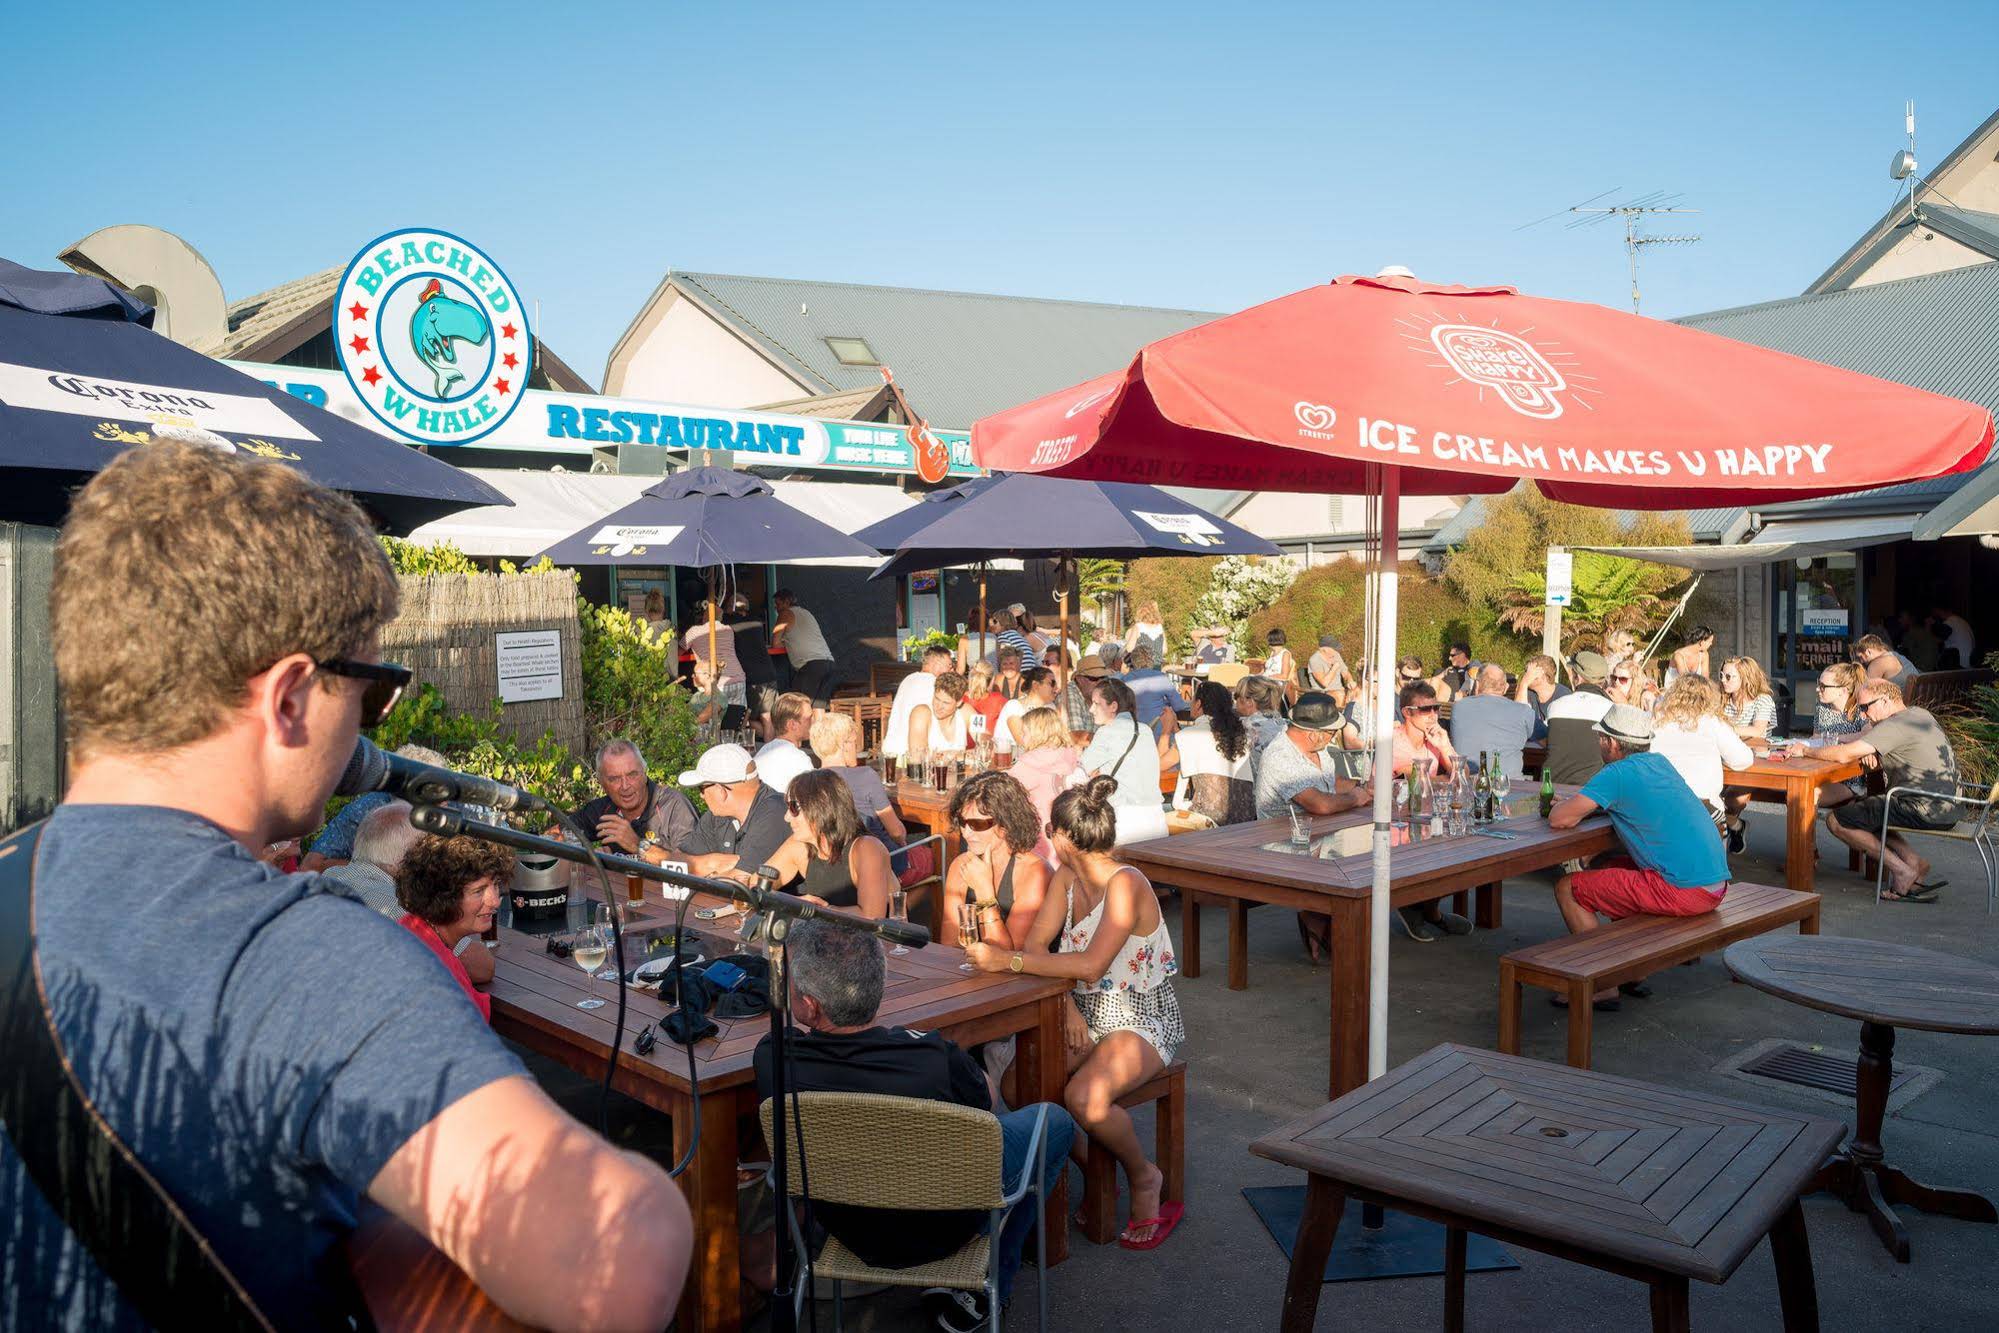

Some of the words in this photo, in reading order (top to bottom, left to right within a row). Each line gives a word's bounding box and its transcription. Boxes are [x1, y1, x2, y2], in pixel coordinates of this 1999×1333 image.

[355, 241, 511, 313] BEACHED
[48, 375, 216, 411] Corona
[120, 398, 194, 417] Extra
[382, 384, 499, 434] WHALE
[547, 404, 805, 455] RESTAURANT
[1358, 417, 1421, 455] ICE
[1432, 431, 1551, 470] CREAM
[1557, 446, 1671, 476] MAKES
[1677, 450, 1707, 476] U
[1714, 444, 1833, 477] HAPPY
[1809, 617, 1841, 625] RECEPTION
[1783, 653, 1843, 665] ITERNET
[972, 715, 984, 728] 44
[528, 894, 567, 908] BECK'S
